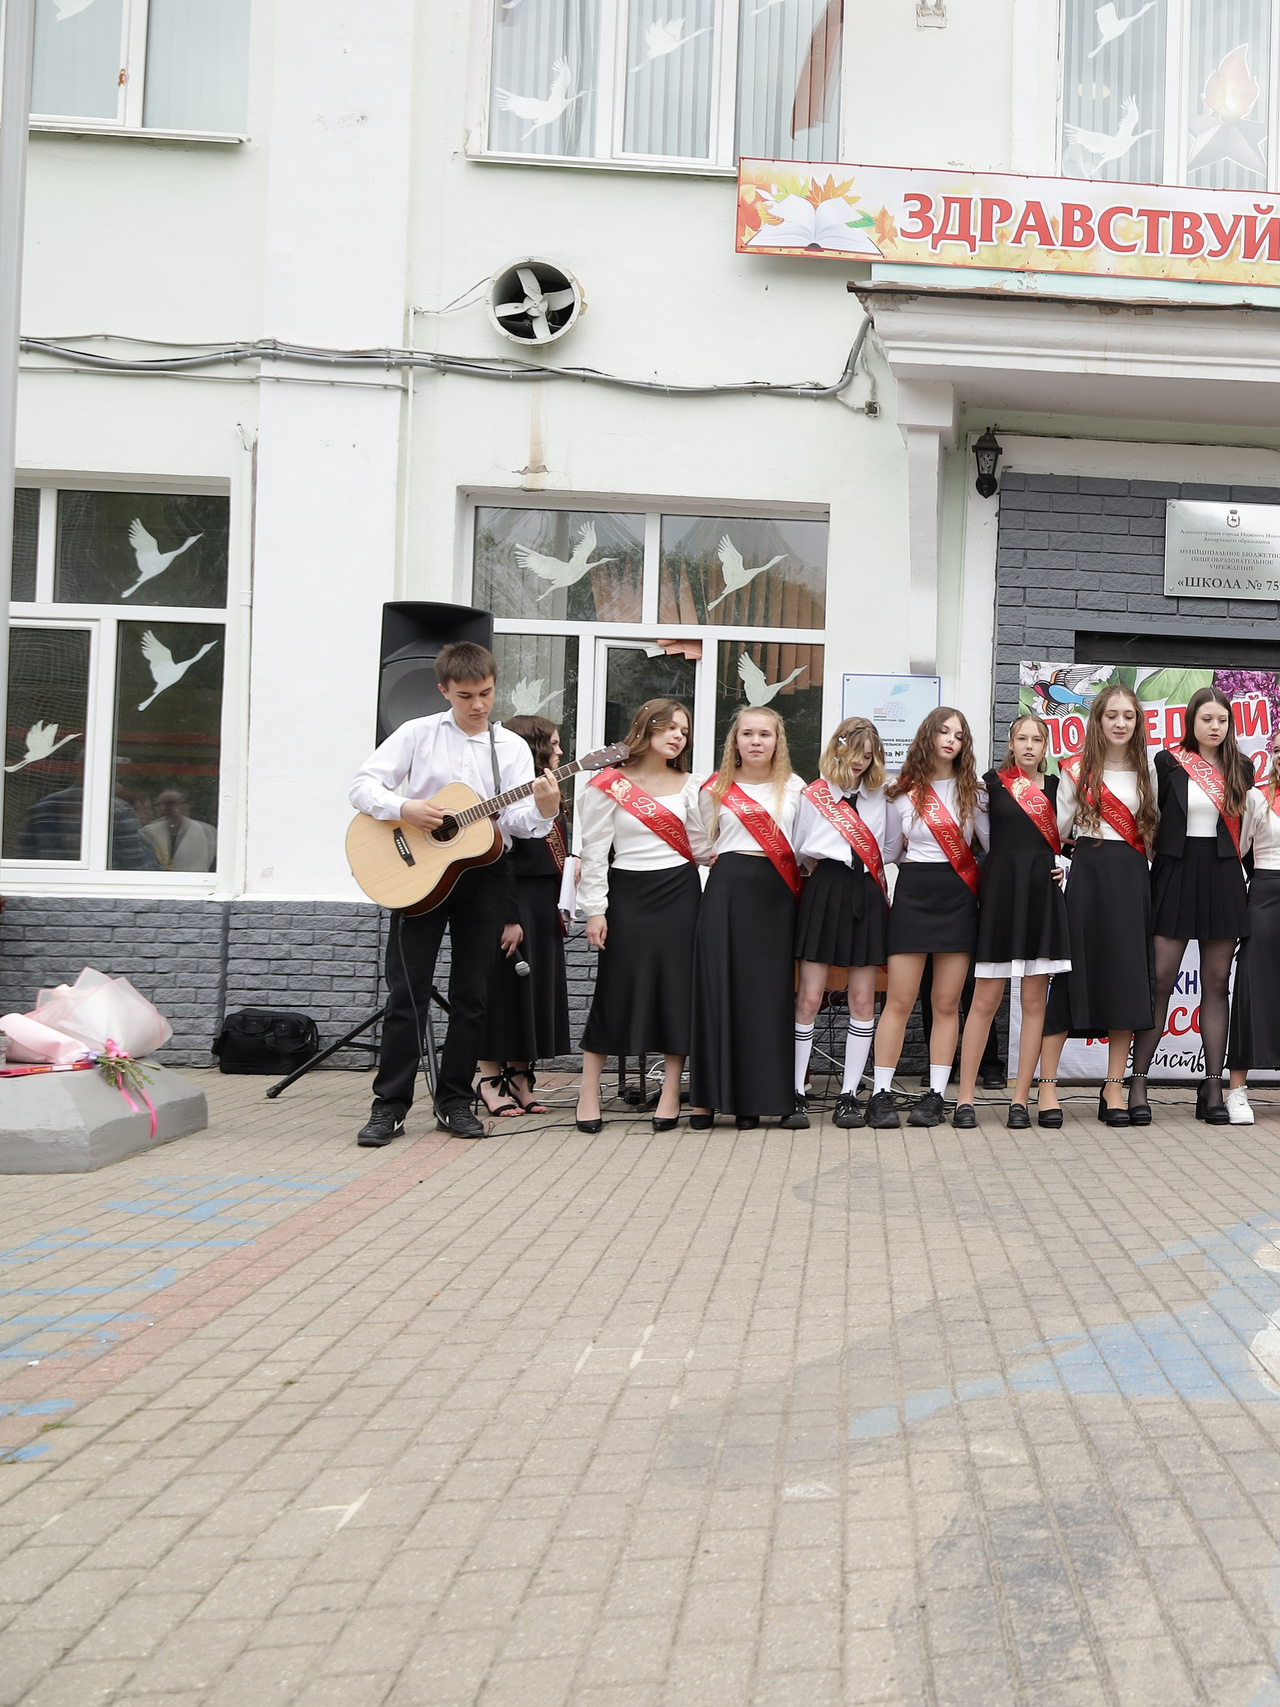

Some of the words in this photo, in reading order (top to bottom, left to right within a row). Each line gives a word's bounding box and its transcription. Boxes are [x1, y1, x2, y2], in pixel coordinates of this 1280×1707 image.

[1177, 576, 1242, 589] «ШКОЛА
[1245, 579, 1263, 590] №
[813, 787, 871, 853] Выпускница
